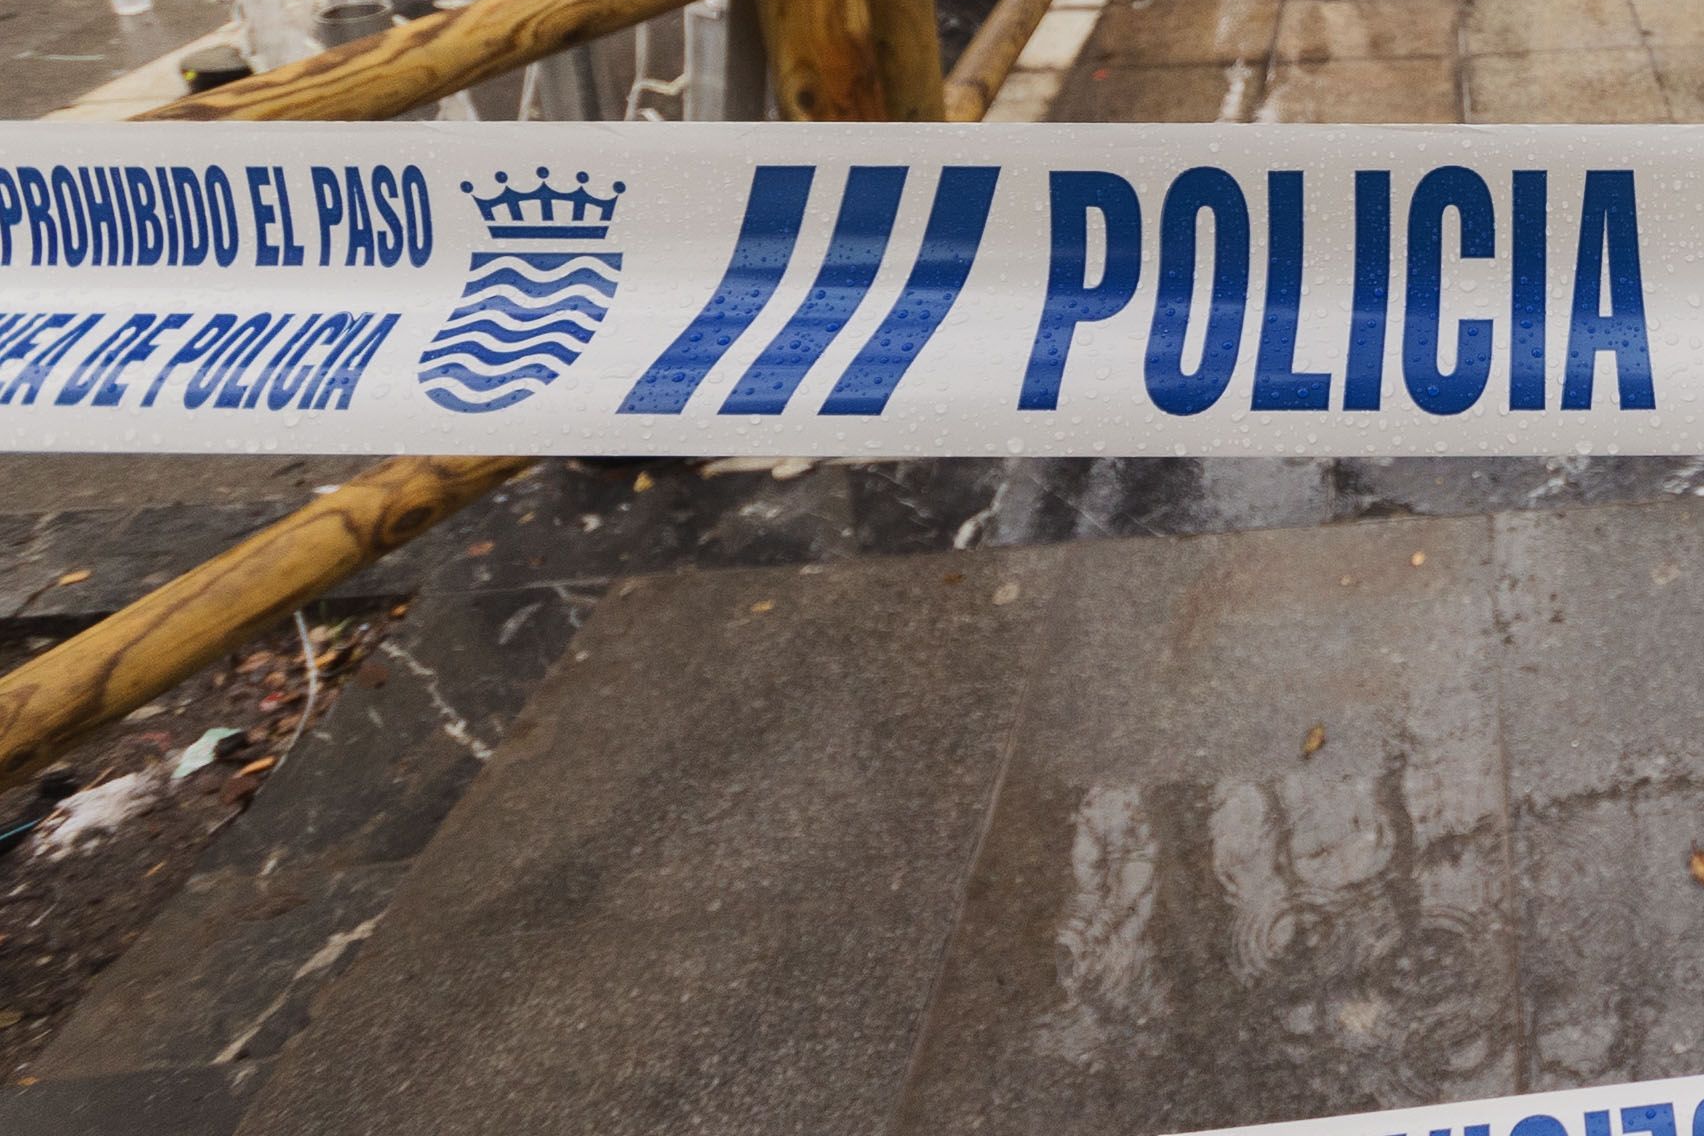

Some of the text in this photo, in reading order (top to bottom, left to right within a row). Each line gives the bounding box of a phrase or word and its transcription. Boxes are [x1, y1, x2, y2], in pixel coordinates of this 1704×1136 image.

[0, 165, 432, 267] PROHIBIDO EL PASO
[1018, 166, 1655, 416] POLICIA
[54, 313, 192, 406] DE
[141, 312, 400, 411] POLICIA
